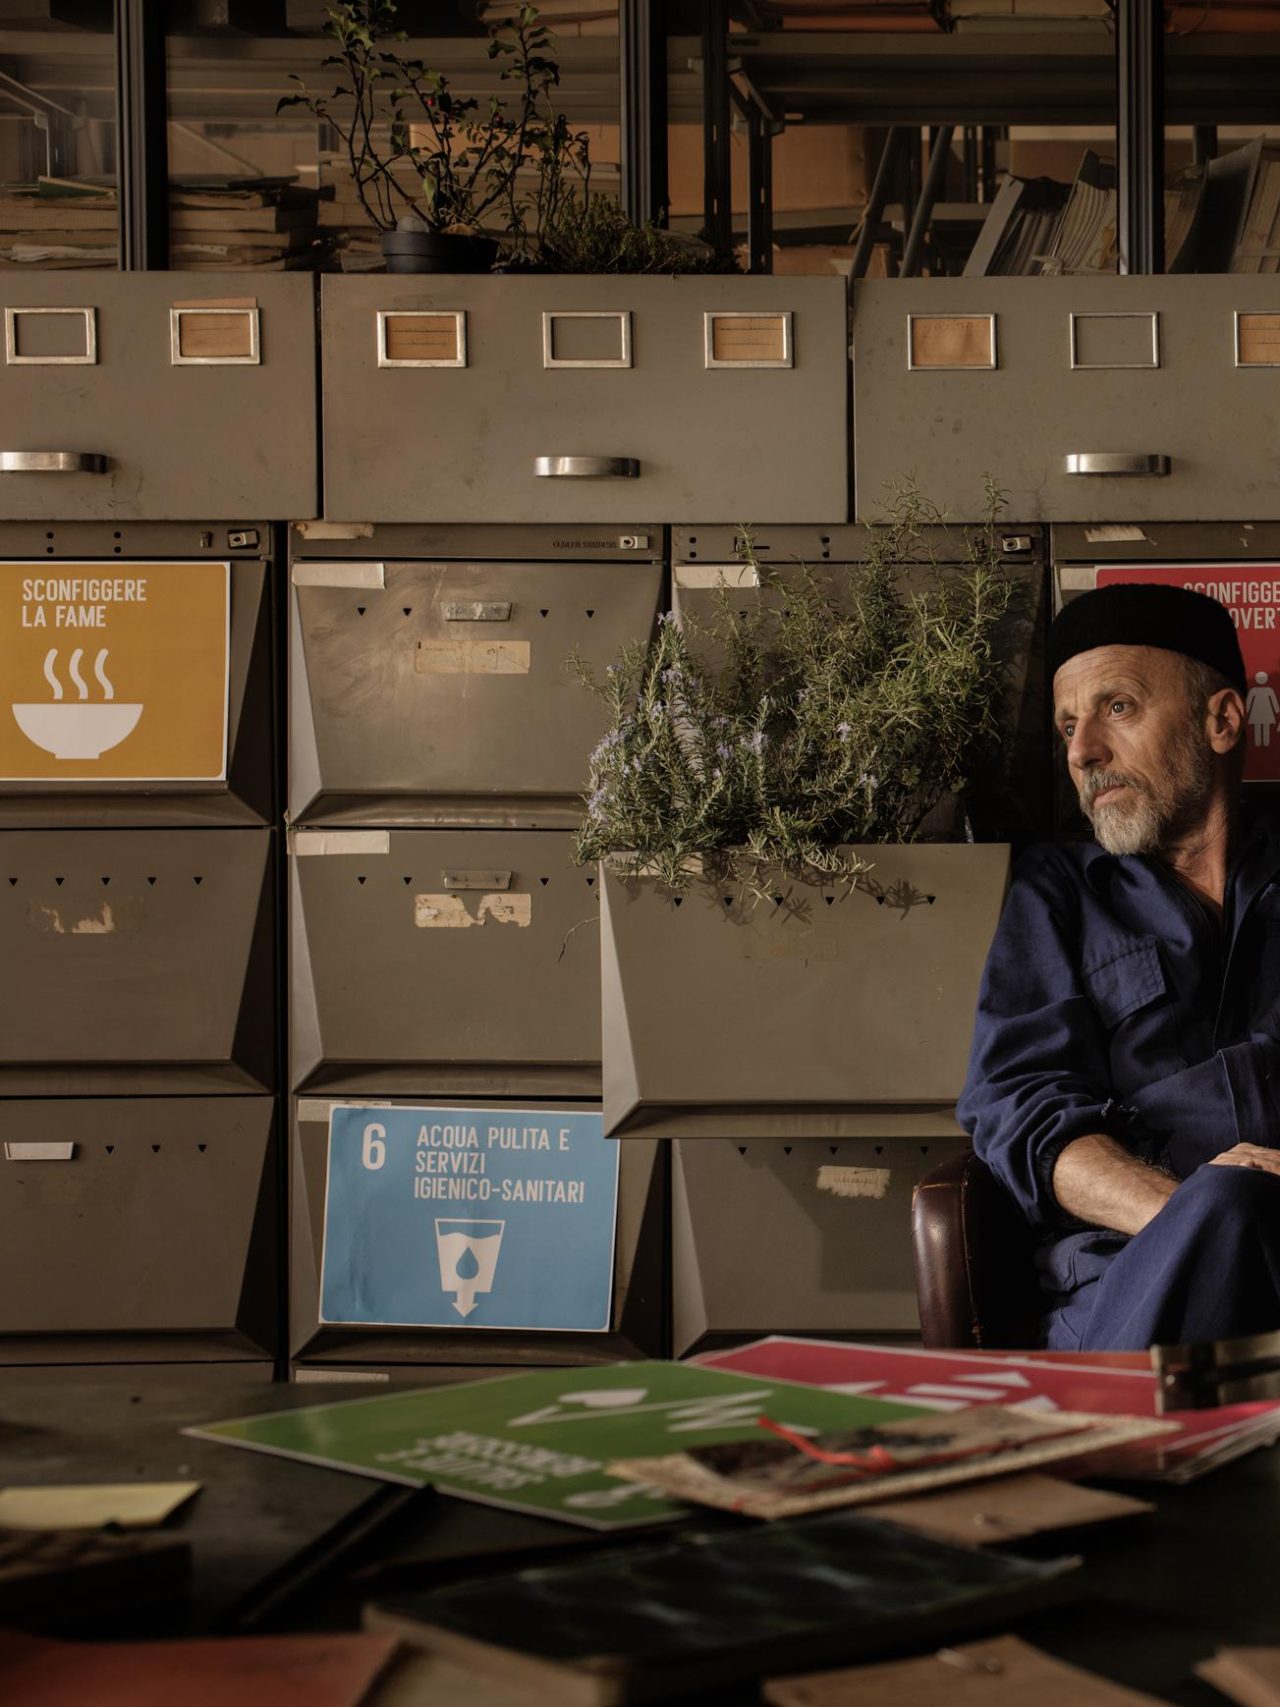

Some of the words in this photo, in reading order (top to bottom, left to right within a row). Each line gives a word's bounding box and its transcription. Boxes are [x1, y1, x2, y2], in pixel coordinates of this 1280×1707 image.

[22, 578, 147, 602] SCONFIGGERE
[22, 605, 46, 628] LA
[55, 605, 107, 628] FAME
[361, 1123, 387, 1171] 6
[416, 1125, 480, 1149] ACQUA
[487, 1126, 551, 1151] PULITA
[558, 1128, 571, 1151] E
[415, 1151, 486, 1175] SERVIZI
[413, 1176, 586, 1204] IGIENICO-SANITARI
